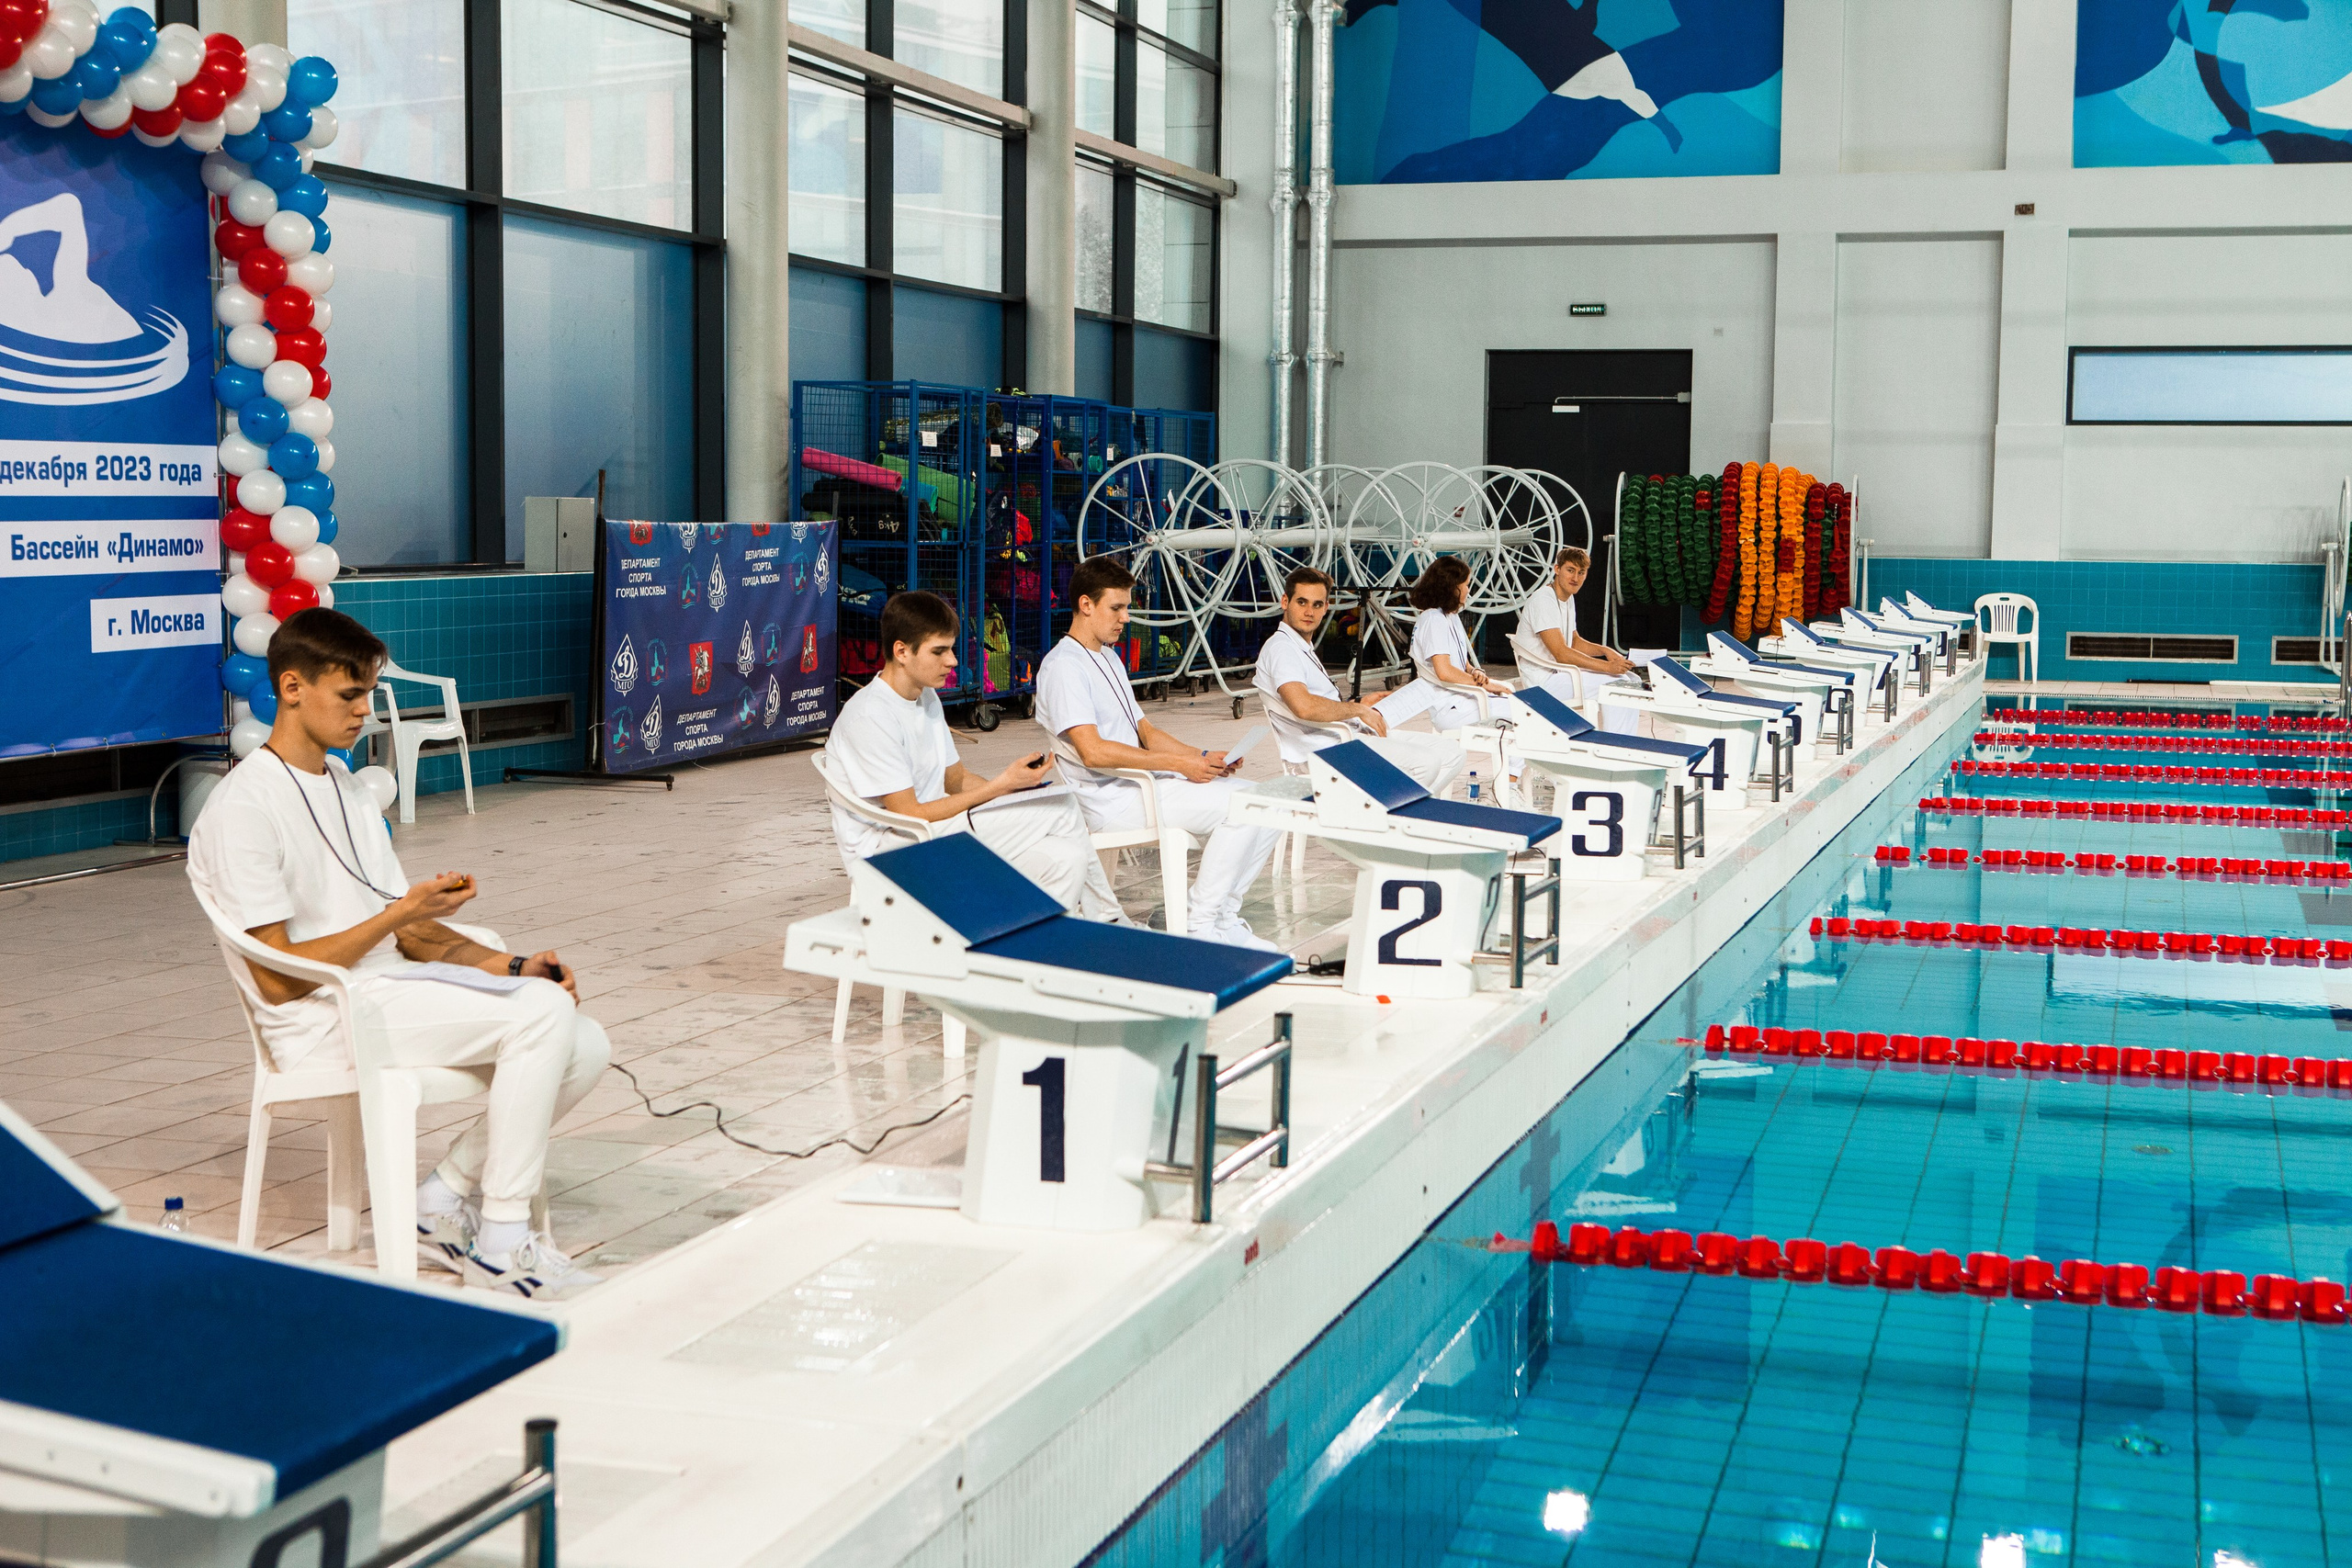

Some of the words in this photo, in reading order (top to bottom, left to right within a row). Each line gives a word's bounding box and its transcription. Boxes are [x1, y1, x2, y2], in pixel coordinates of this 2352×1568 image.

[0, 455, 87, 488] декабря
[96, 455, 152, 481] 2023
[159, 462, 202, 486] года
[11, 534, 99, 561] Бассейн
[107, 532, 204, 563] «Динамо»
[745, 547, 779, 561] ДЕПАРТАМЕНТ
[621, 558, 661, 570] ДЕПАРТАМЕНТ
[752, 561, 772, 572] СПОРТА
[628, 572, 652, 583] СПОРТА
[741, 576, 760, 587] ГОРОДА
[760, 573, 780, 585] МОСКВЫ
[616, 588, 639, 599] ГОРОДА
[639, 585, 667, 597] МОСКВЫ
[107, 617, 122, 637] г.
[130, 609, 205, 635] Москва
[616, 680, 632, 690] МГО
[790, 686, 825, 702] ДЕПАРТАМЕНТ
[797, 700, 818, 712] СПОРТА
[676, 708, 717, 725] ДЕПАРТАМЕНТ
[786, 714, 808, 727] ГОРОДА
[808, 710, 827, 723] МОСКВЫ
[684, 723, 708, 736] СПОРТА
[673, 739, 697, 751] ГОРОДА
[697, 734, 724, 747] МОСКВЫ
[1688, 738, 1729, 791] 4
[1572, 791, 1623, 857] 3
[1378, 879, 1442, 966] 2
[1167, 1042, 1190, 1163] 1
[1022, 1056, 1065, 1182] 1
